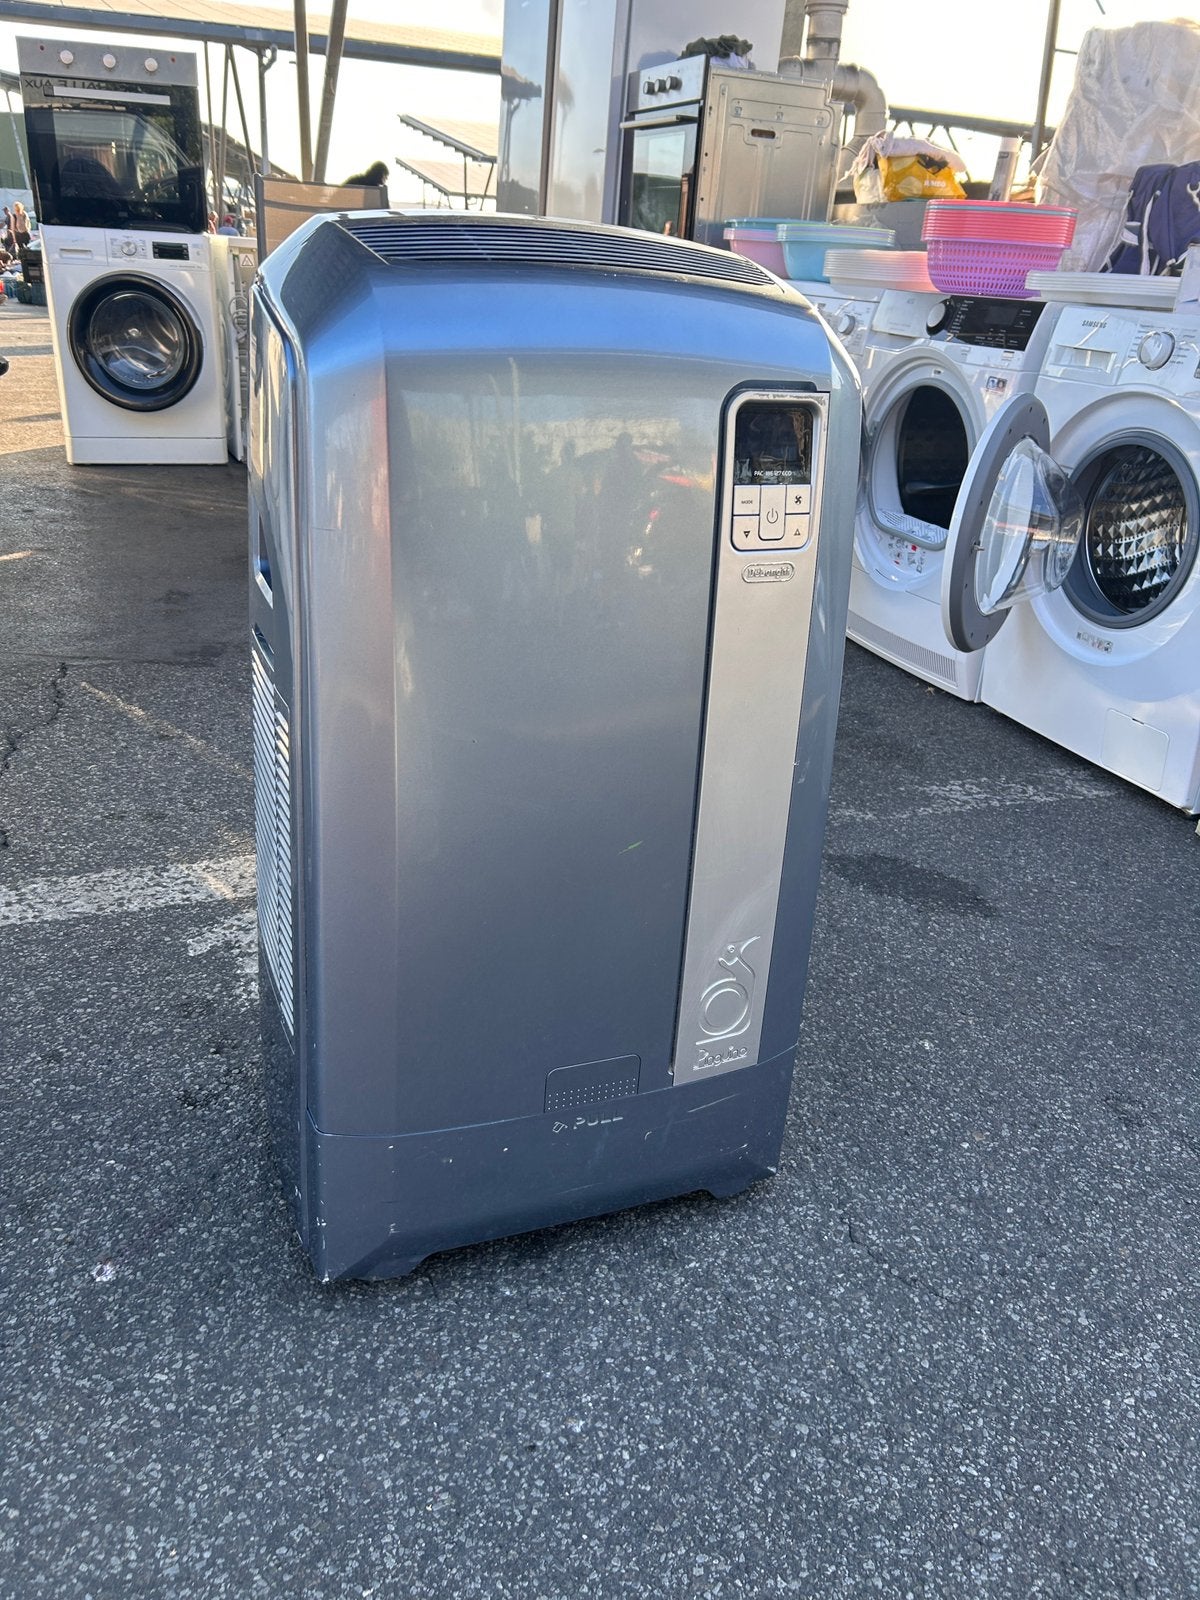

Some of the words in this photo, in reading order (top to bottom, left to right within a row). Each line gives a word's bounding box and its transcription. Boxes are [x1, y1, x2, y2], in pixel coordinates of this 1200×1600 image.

[1081, 319, 1107, 328] SAMSUNG
[695, 1046, 748, 1069] Pinguino
[573, 1110, 624, 1130] PULL
